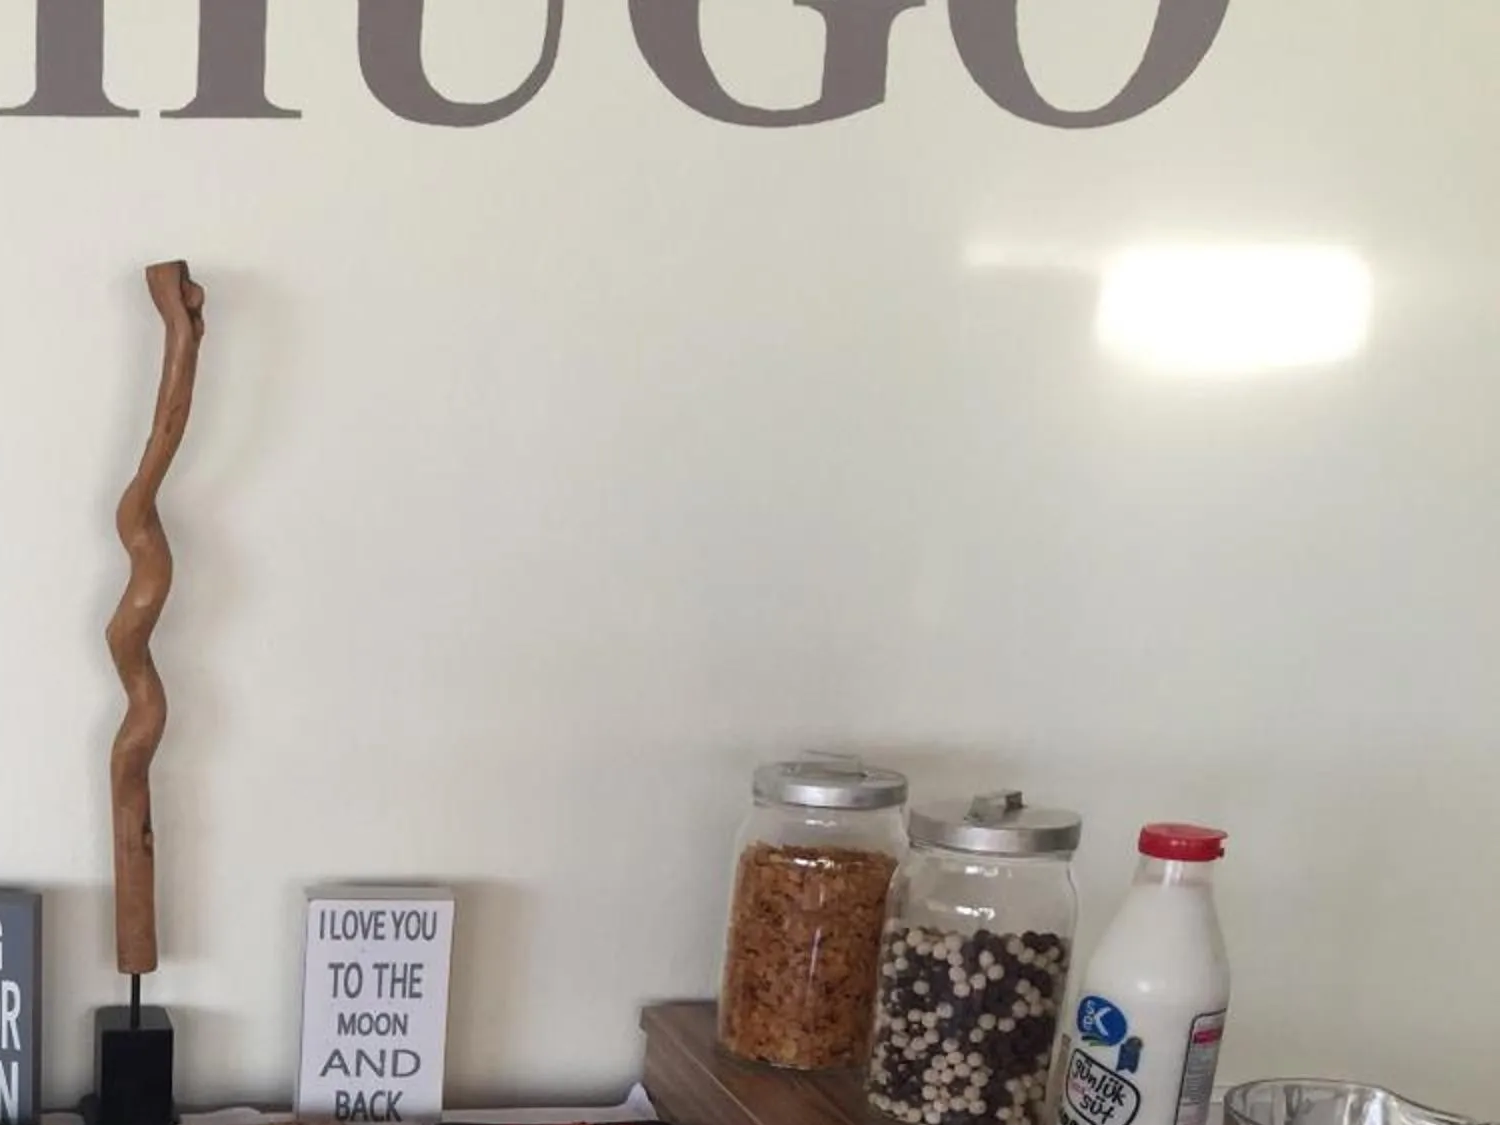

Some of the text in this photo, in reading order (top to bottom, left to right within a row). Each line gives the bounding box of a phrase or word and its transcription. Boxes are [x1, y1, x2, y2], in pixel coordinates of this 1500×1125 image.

[319, 909, 438, 942] I LOVE YOU
[328, 962, 424, 1000] TO THE
[337, 1011, 409, 1036] MOON
[319, 1048, 422, 1078] AND
[1072, 1058, 1126, 1106] günlük
[334, 1089, 404, 1122] BACK
[1080, 1095, 1115, 1125] süt
